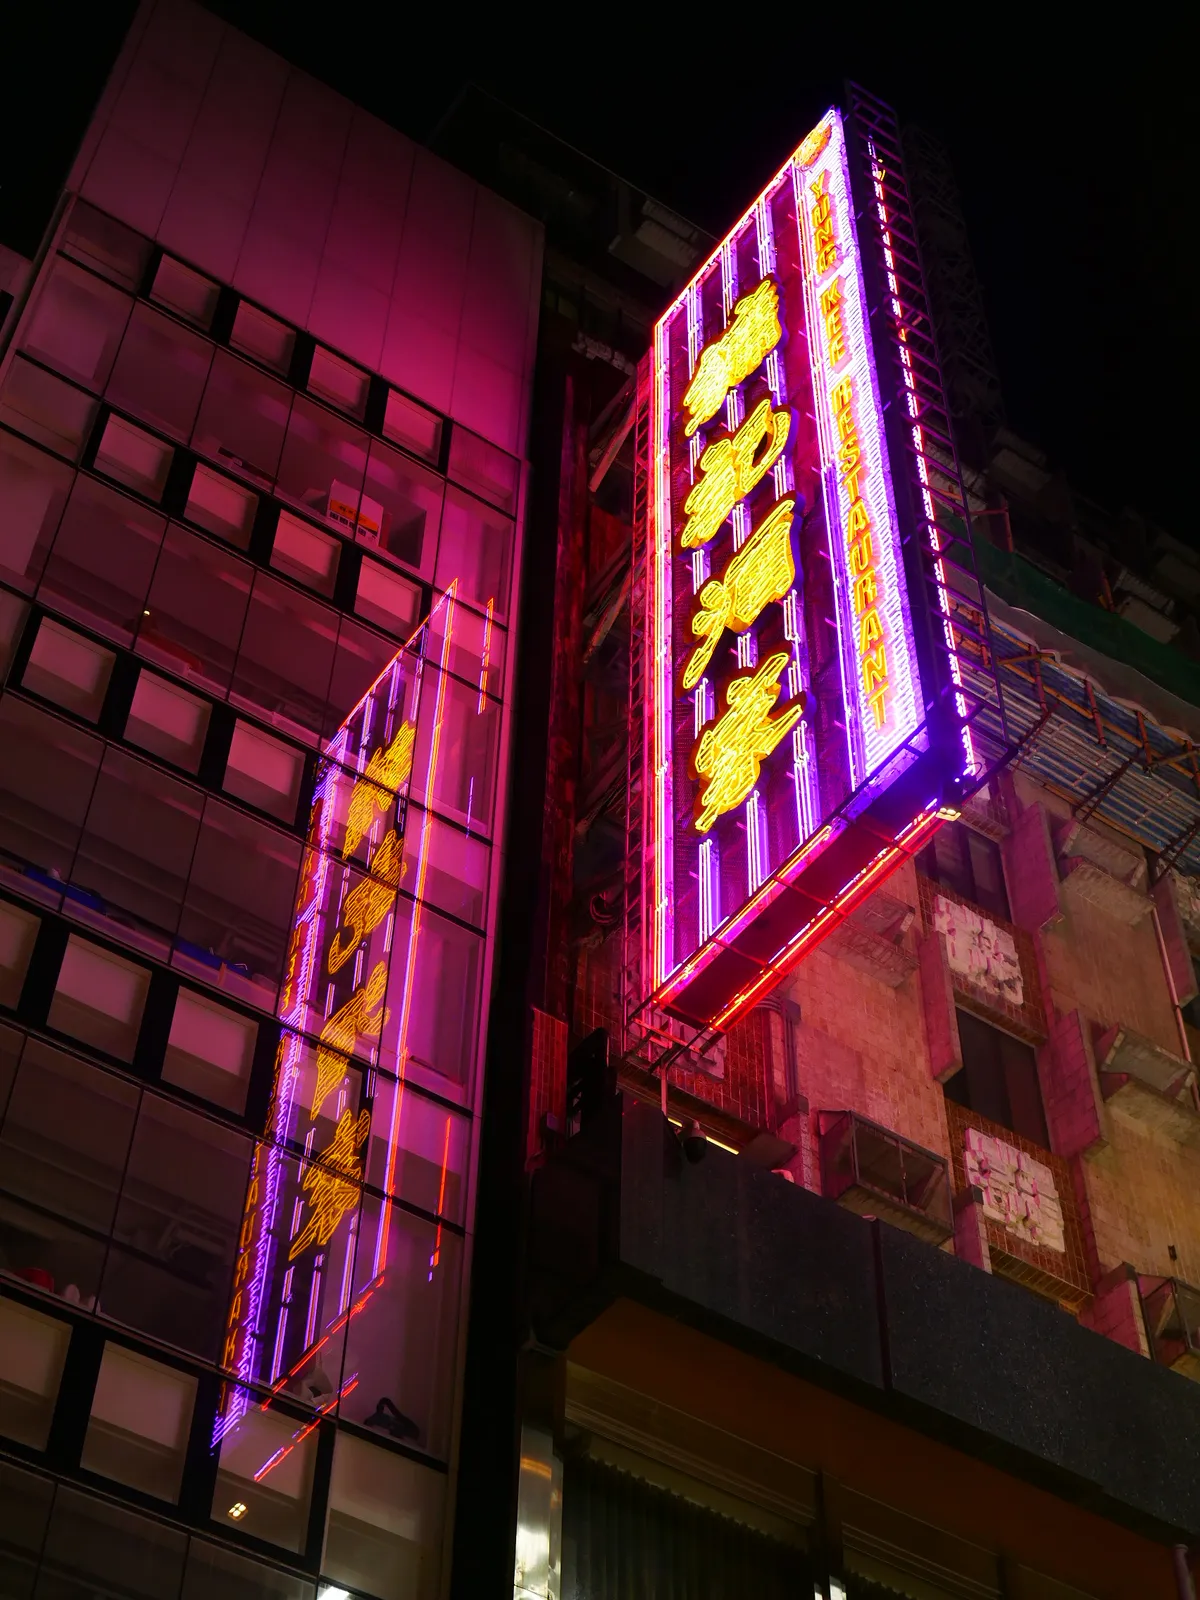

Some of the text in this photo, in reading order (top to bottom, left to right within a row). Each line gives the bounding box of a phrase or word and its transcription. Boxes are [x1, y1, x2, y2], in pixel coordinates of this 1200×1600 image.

[810, 172, 889, 731] YUNG KEE RESTAURANT
